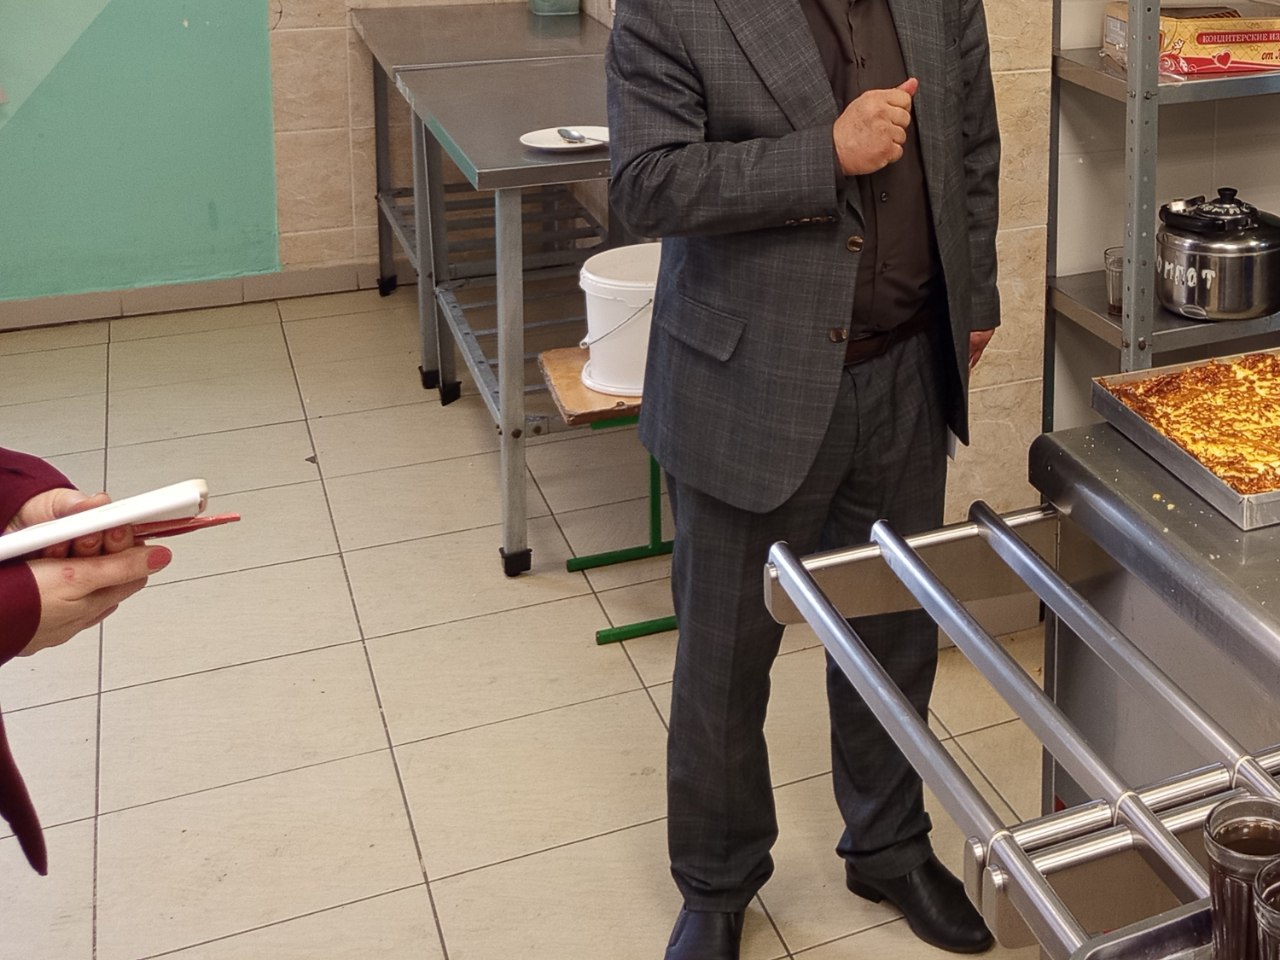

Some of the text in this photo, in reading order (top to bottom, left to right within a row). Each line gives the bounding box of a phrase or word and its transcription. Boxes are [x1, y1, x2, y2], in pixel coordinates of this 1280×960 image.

[1202, 33, 1268, 43] КОНДИТЕРСКИЕ
[1261, 51, 1273, 60] от
[1157, 255, 1216, 290] ОМПОТ
